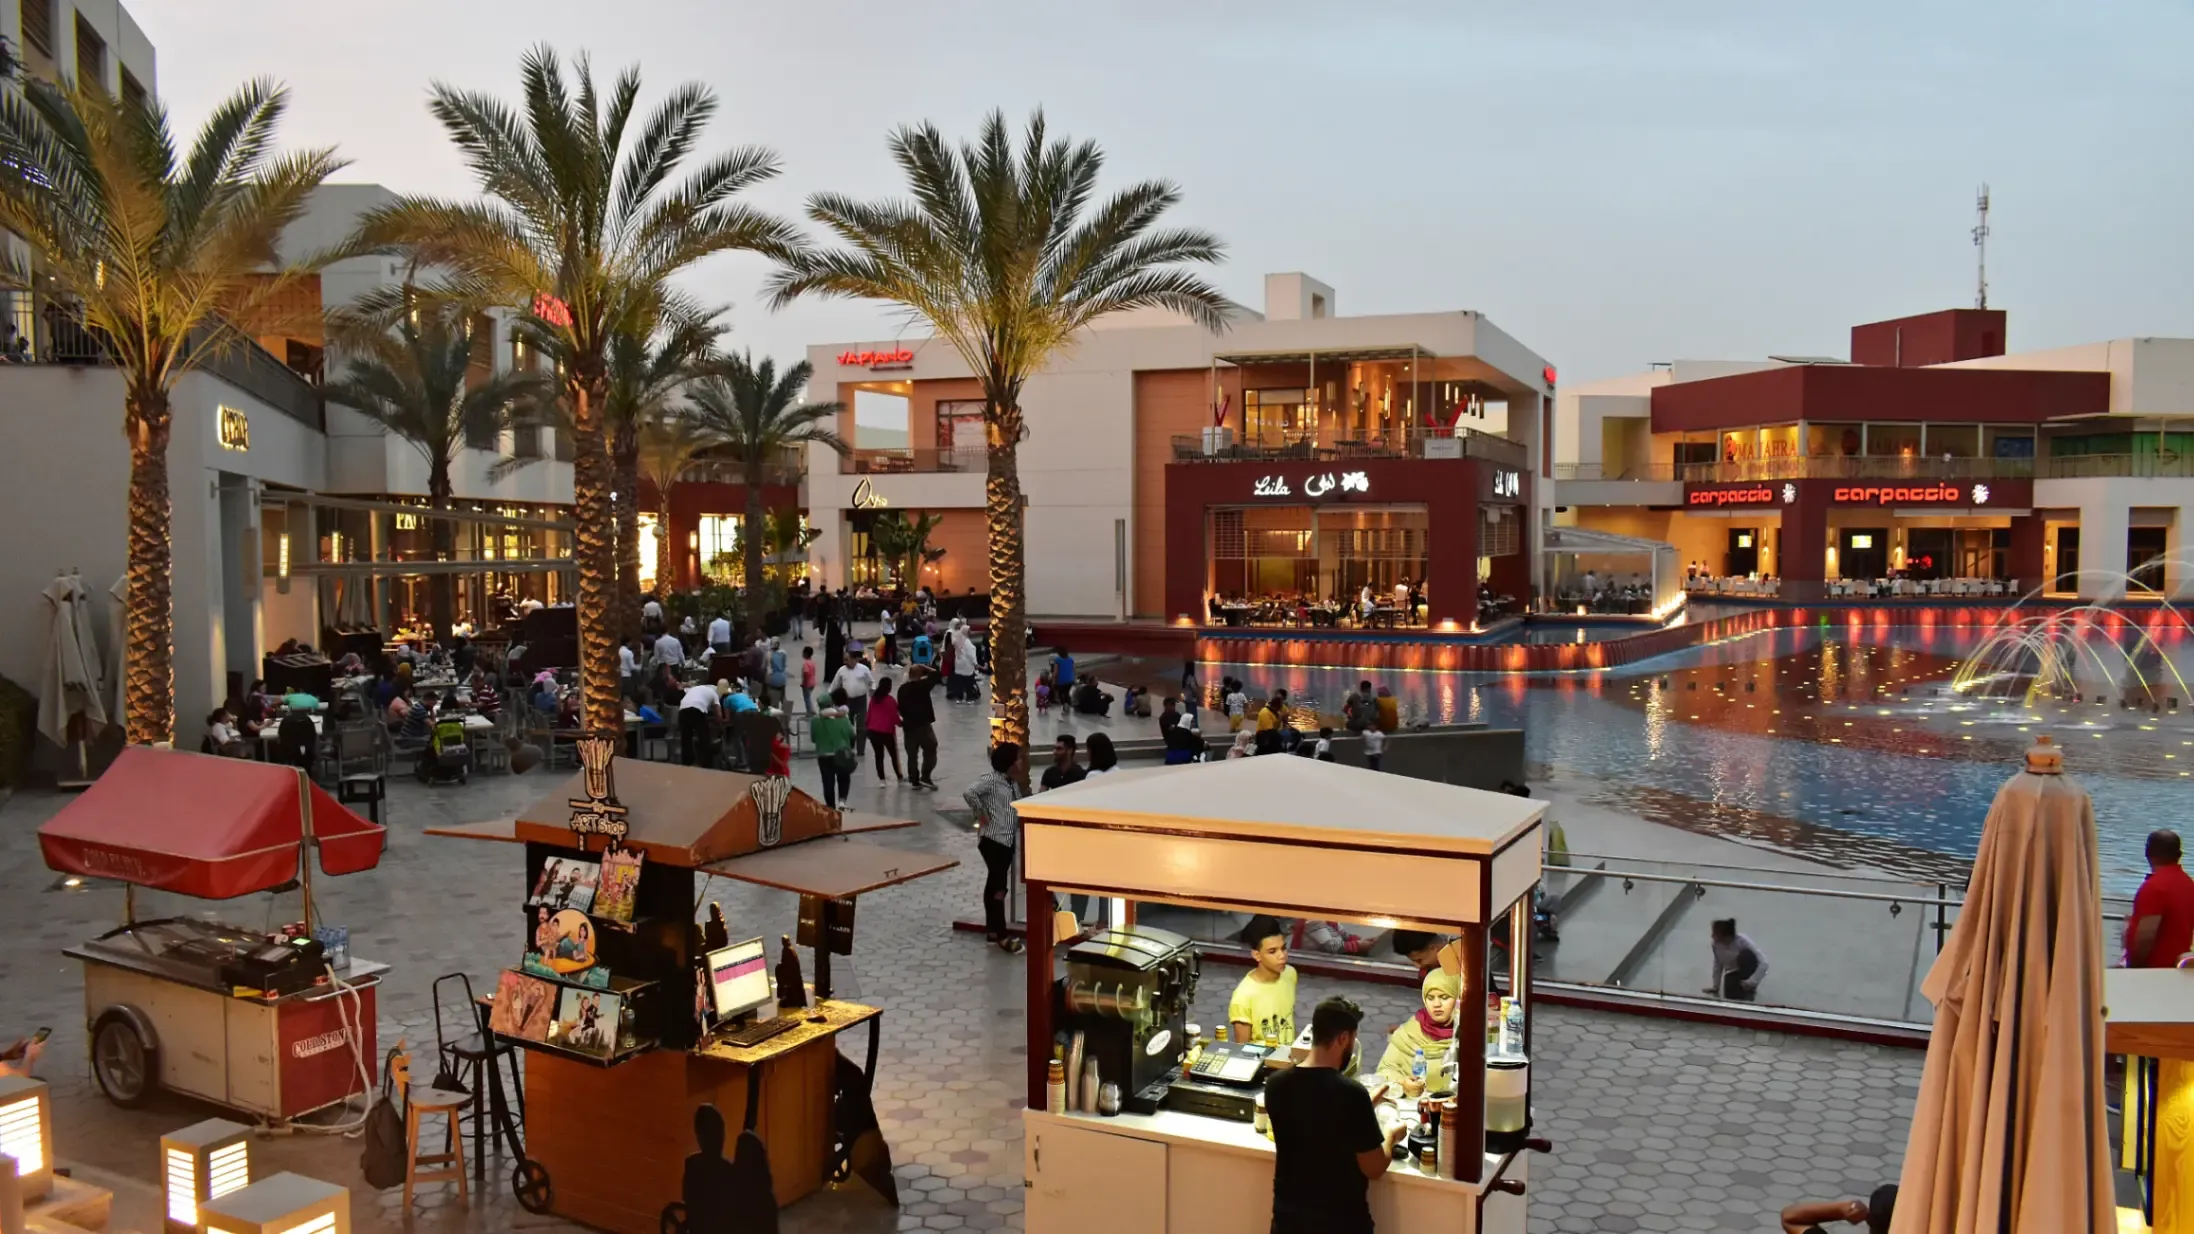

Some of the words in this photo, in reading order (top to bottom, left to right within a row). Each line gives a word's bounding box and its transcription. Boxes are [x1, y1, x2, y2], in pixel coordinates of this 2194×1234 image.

[836, 348, 914, 367] VAPIANO
[1253, 475, 1292, 496] Leila
[1690, 484, 1773, 507] carpaccio
[1834, 482, 1960, 505] carpaccio
[570, 812, 600, 833] ART
[292, 1034, 319, 1058] COLD
